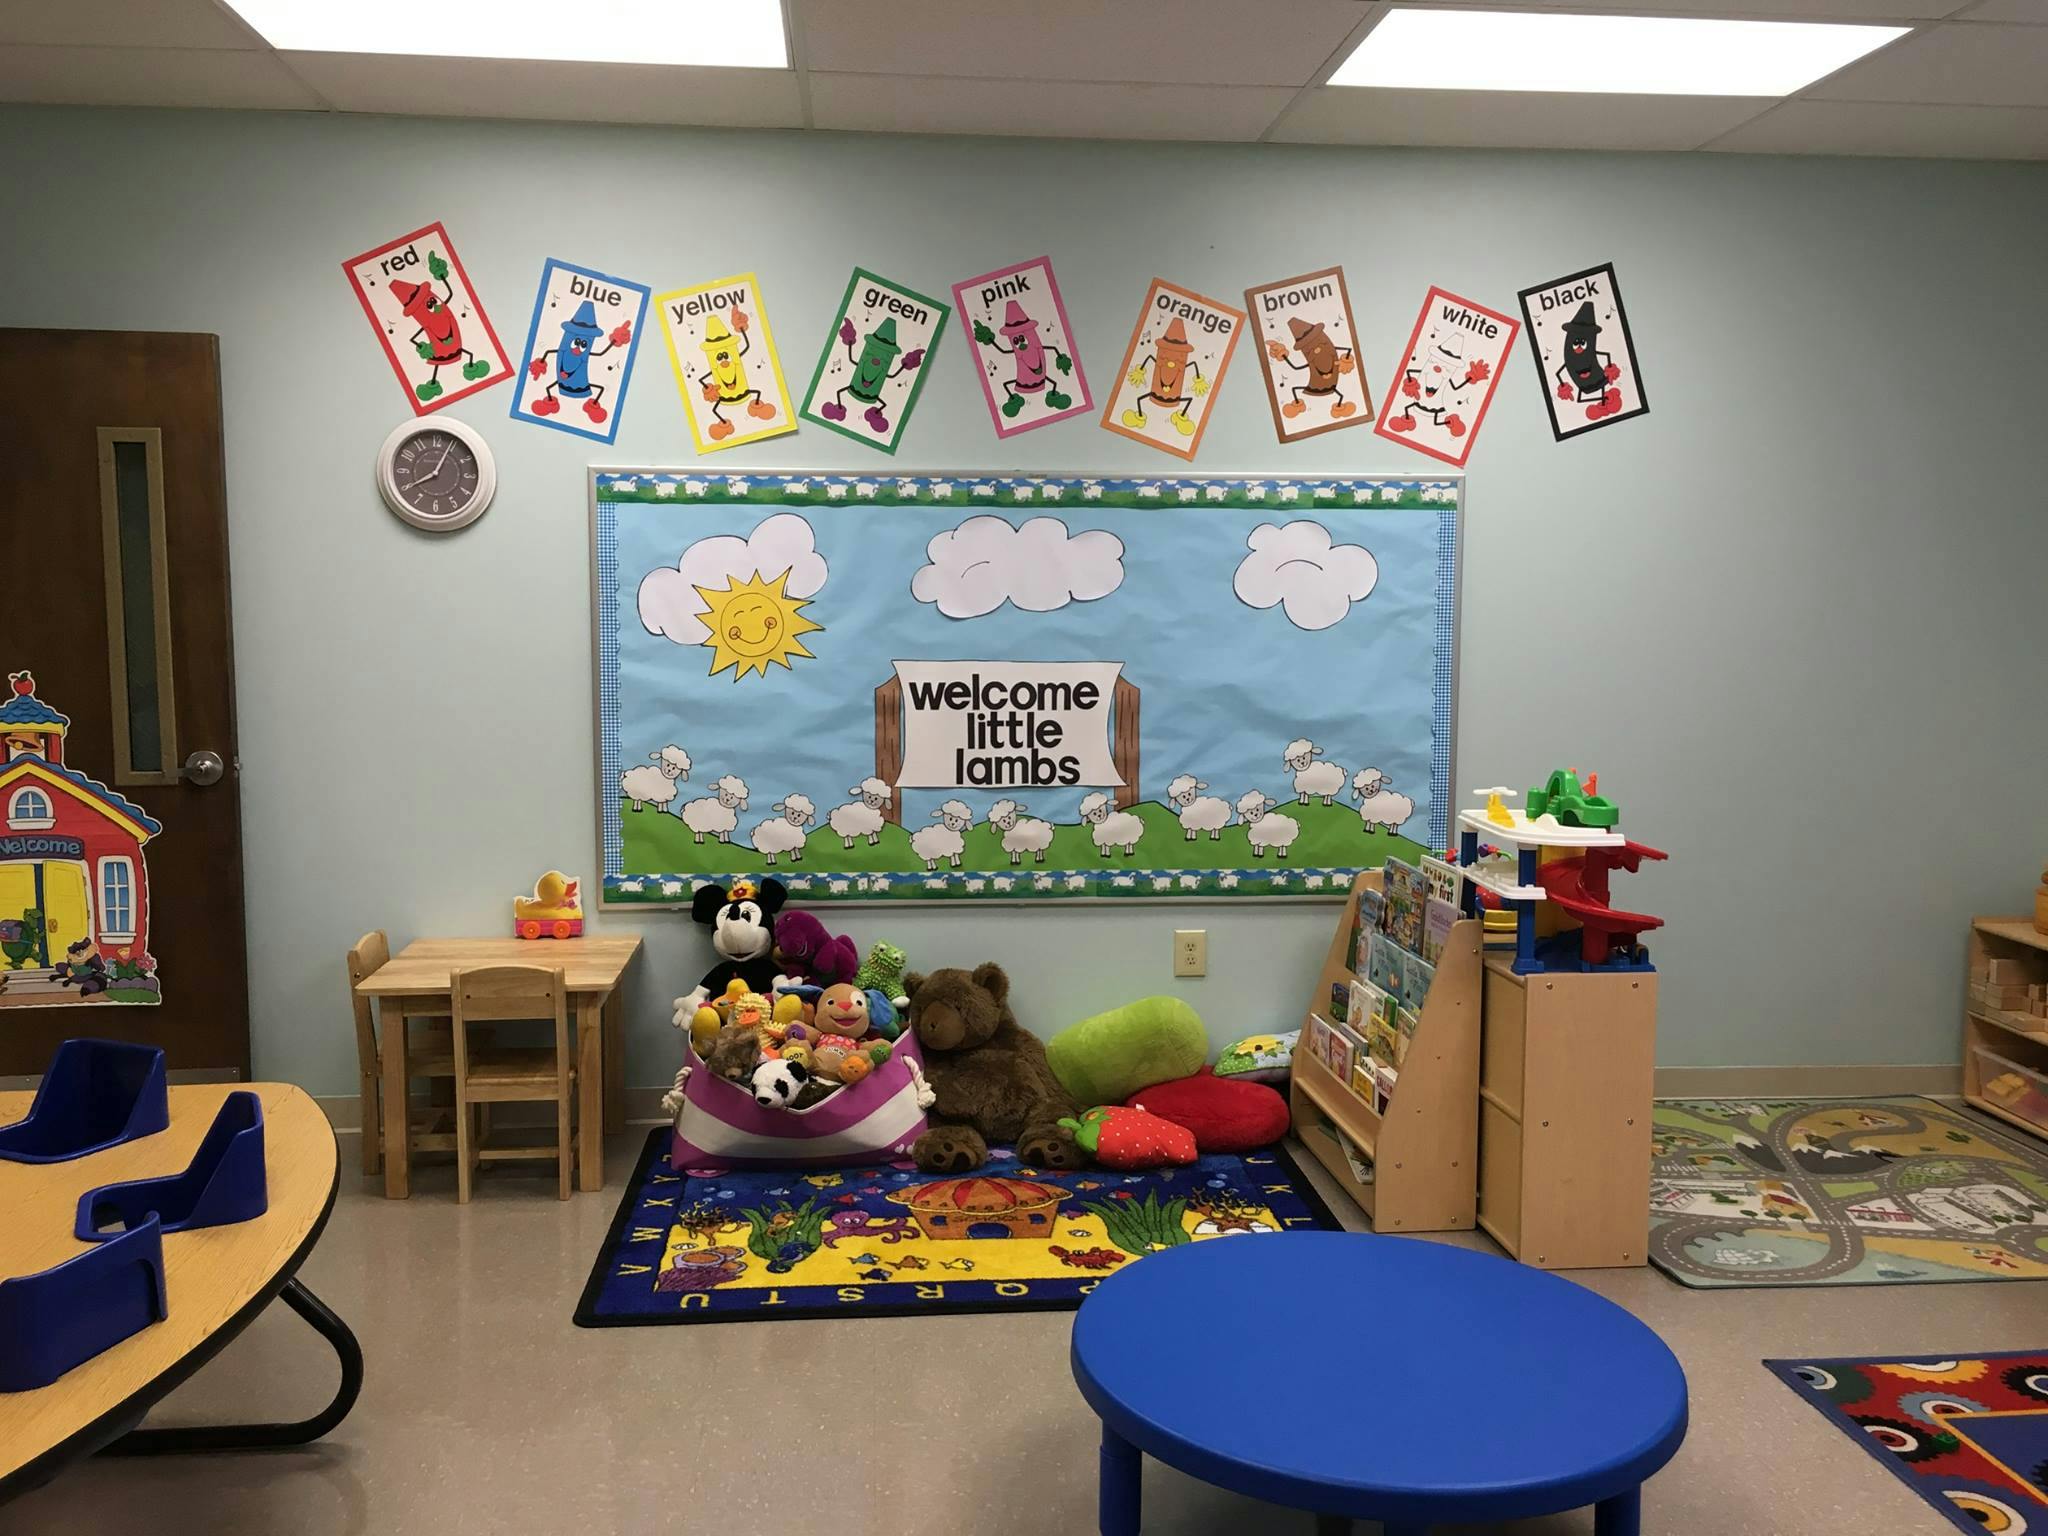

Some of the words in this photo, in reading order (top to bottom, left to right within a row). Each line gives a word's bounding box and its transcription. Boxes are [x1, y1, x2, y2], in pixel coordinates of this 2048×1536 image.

[380, 244, 420, 276] red
[570, 275, 622, 306] blue
[981, 273, 1031, 305] pink
[1263, 281, 1333, 313] brown
[1539, 279, 1600, 312] black
[671, 288, 746, 325] yellow
[863, 287, 928, 326] green
[1156, 294, 1232, 335] orange
[1443, 304, 1498, 339] white
[414, 438, 427, 452] 11
[432, 435, 442, 448] 12
[401, 449, 415, 462] 10
[460, 455, 472, 464] 2
[414, 493, 424, 505] 7
[460, 487, 472, 496] 4
[433, 500, 439, 513] 6
[449, 496, 458, 509] 5
[908, 673, 1100, 711] welcome
[966, 711, 1064, 750] little
[955, 748, 1081, 786] lambs
[1439, 884, 1454, 904] first
[652, 1174, 680, 1184] Y
[643, 1198, 675, 1208] X
[1262, 1184, 1293, 1194] K
[1283, 1217, 1312, 1226] L
[629, 1226, 664, 1242] W
[616, 1263, 652, 1276] V
[837, 1287, 864, 1302] S
[916, 1284, 944, 1299] R
[994, 1281, 1029, 1296] Q
[680, 1293, 710, 1309] U
[760, 1290, 786, 1305] T
